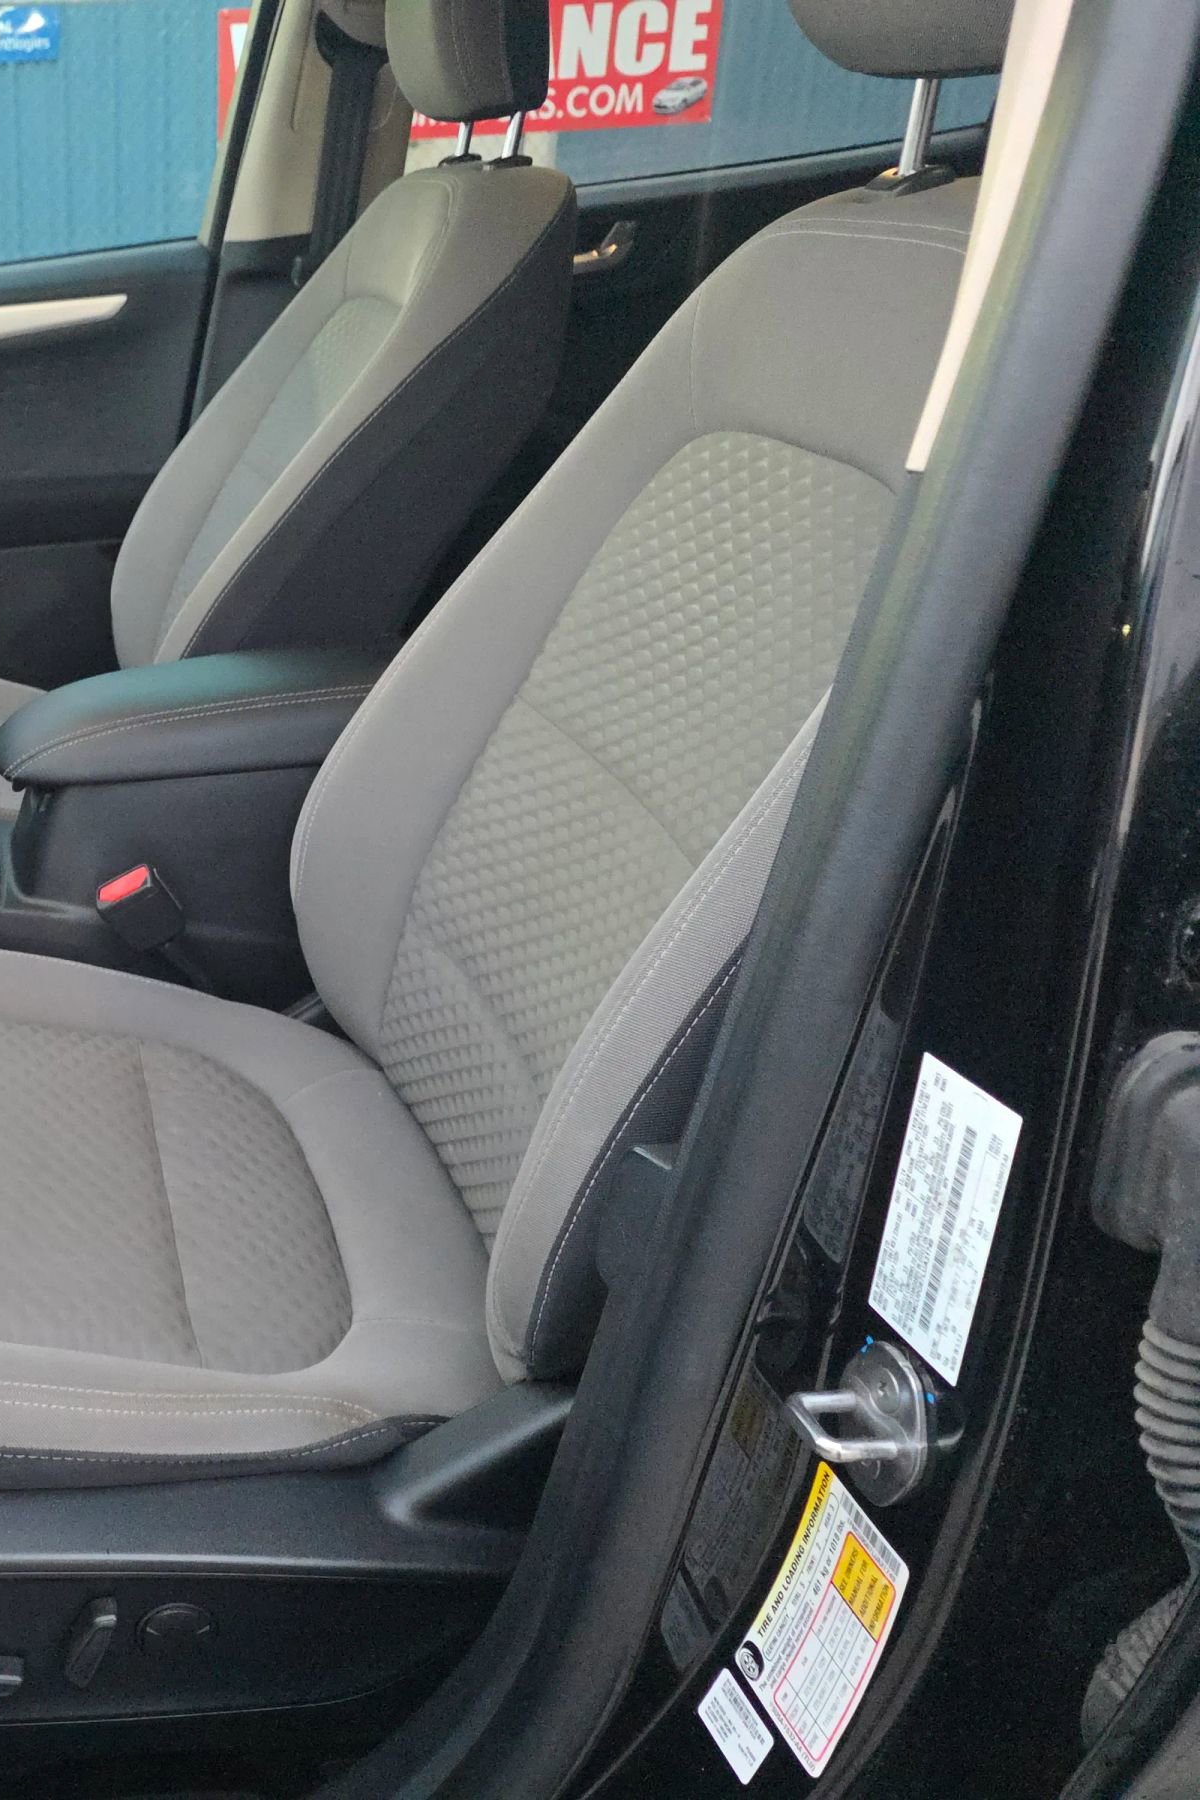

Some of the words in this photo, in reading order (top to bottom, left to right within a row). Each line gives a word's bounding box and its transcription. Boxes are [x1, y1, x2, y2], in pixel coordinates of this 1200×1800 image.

[758, 1612, 773, 1638] TIRE
[771, 1589, 785, 1614] AND
[783, 1543, 805, 1591] LOADING
[803, 1470, 829, 1544] INFORMATION
[812, 1577, 822, 1597] 461
[820, 1563, 830, 1579] kg
